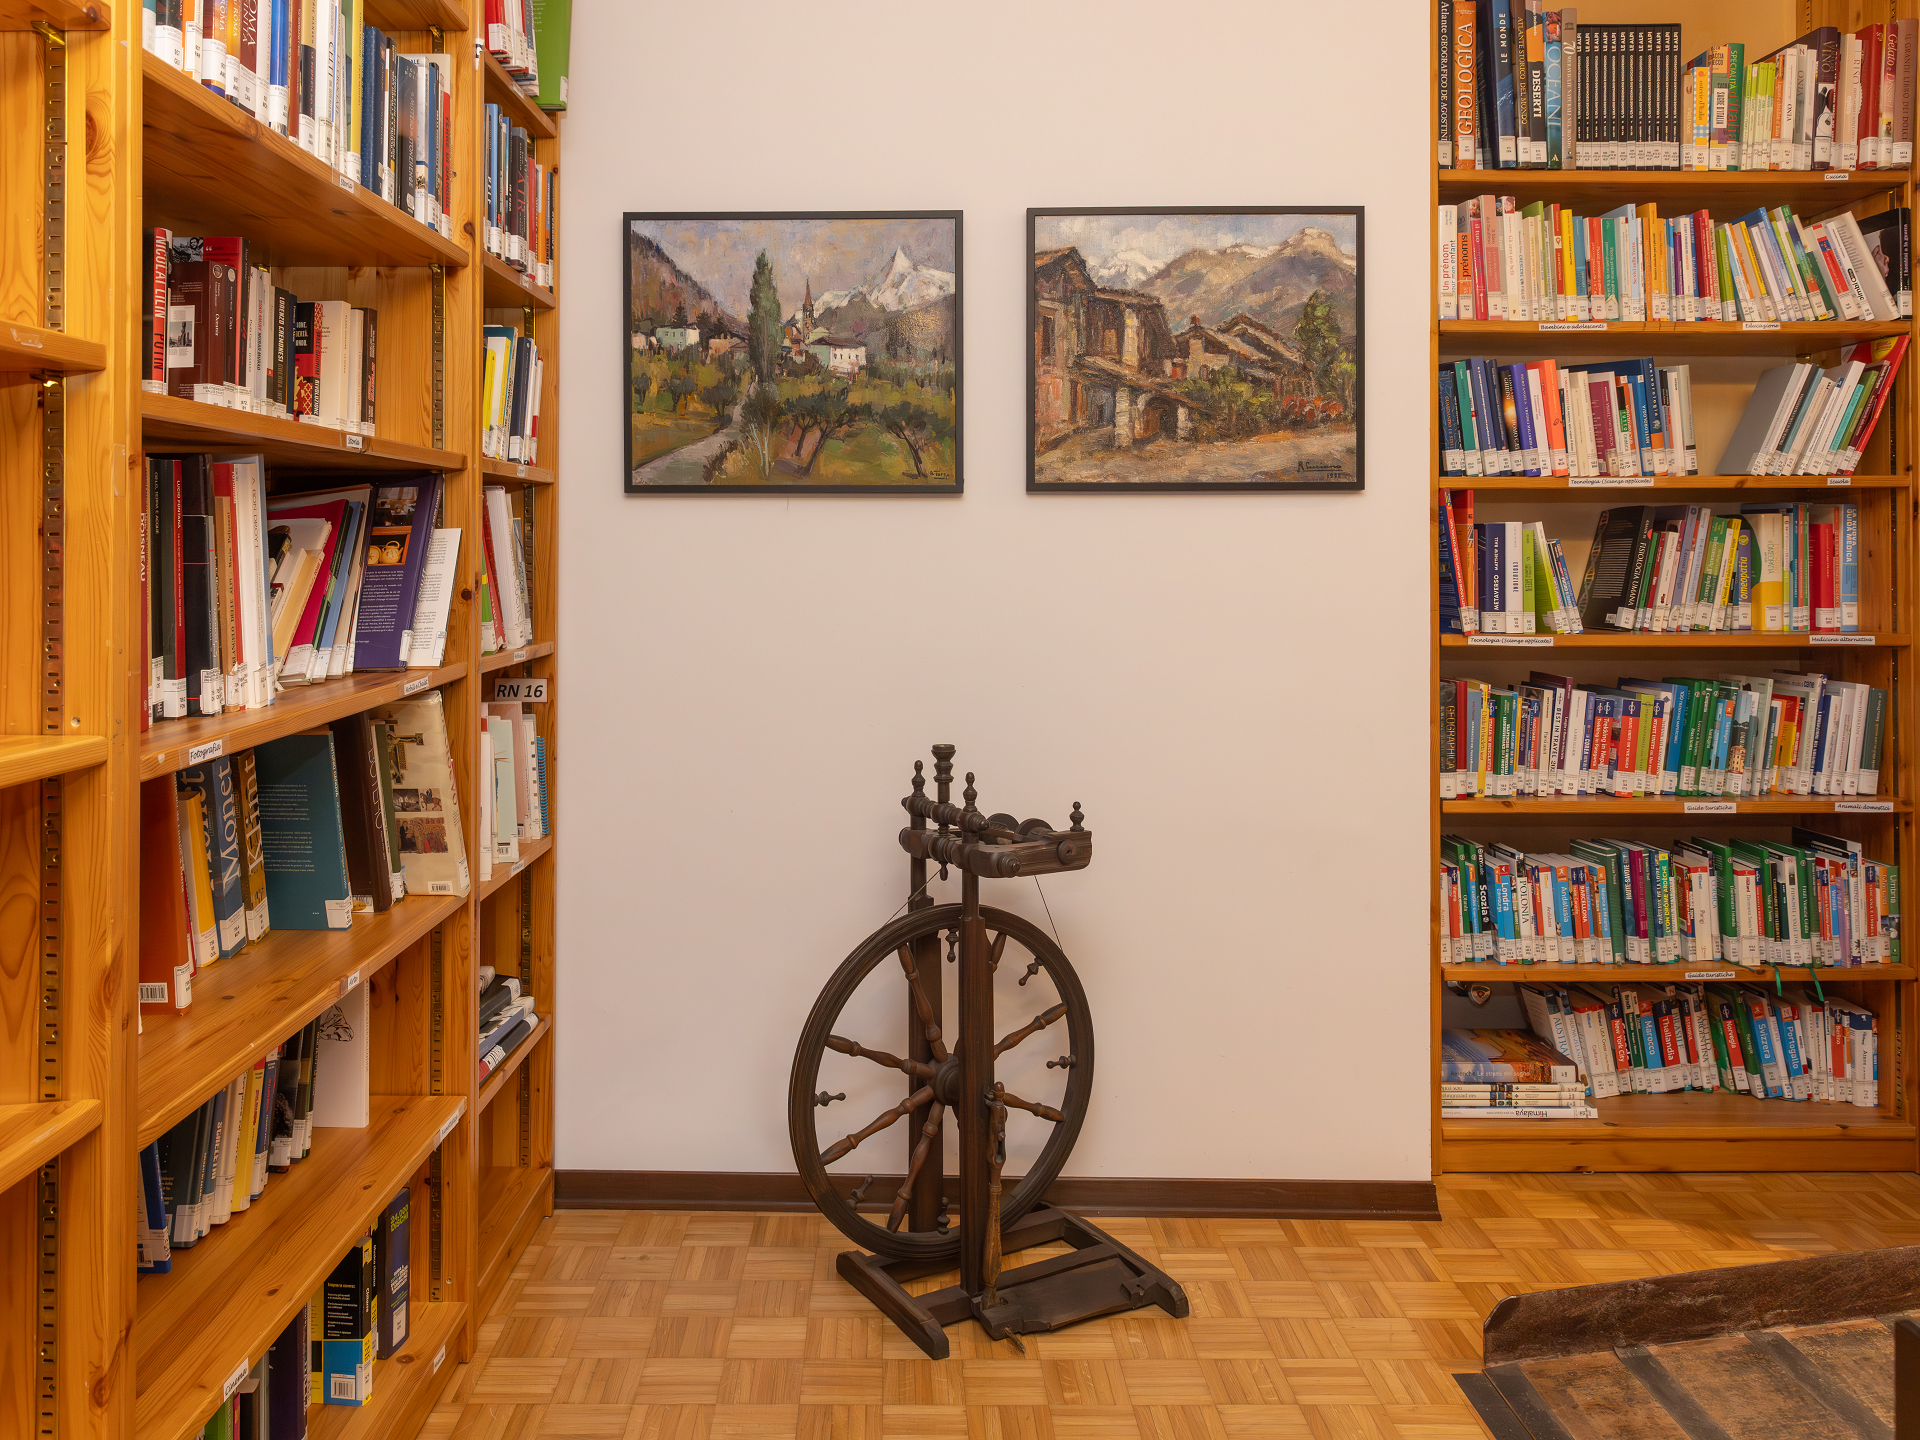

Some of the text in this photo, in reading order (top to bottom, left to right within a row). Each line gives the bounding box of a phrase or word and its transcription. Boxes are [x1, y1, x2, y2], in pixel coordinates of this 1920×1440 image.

[1441, 1, 1449, 33] Atlante
[1501, 53, 1507, 63] LE
[1563, 41, 1576, 55] 70
[1821, 41, 1832, 73] VINO
[1458, 22, 1473, 135] GEOLOGICA
[1547, 46, 1561, 126] OCEANI
[1797, 70, 1805, 97] VINO
[1852, 59, 1860, 84] RISO
[1886, 34, 1897, 108] Gelato Dessert
[1441, 90, 1448, 101] DE
[1532, 70, 1541, 118] DESERTI
[1716, 92, 1726, 106] SAGRE
[1727, 50, 1741, 141] SPECIALITÀ d'Italia
[407, 137, 415, 188] STONEHENGE
[517, 171, 525, 212] AIR
[1441, 244, 1449, 290] Un prénom
[1459, 234, 1471, 277] prénoms
[154, 235, 166, 370] NICOLAI LILIN PUTIN
[277, 326, 285, 362] CREMONESI
[1852, 509, 1856, 518] LA
[1628, 542, 1646, 606] FISIOLOGIA UMANA
[497, 685, 543, 698] RN 16
[1803, 680, 1815, 688] cane
[190, 743, 221, 761] Fotografia
[1446, 705, 1456, 770] GEOGRAPHICA
[219, 760, 241, 890] Monet
[244, 755, 263, 872] Klimt
[1480, 885, 1488, 915] Scozia
[1501, 882, 1510, 911] Londra
[1520, 880, 1529, 923] POLONIA
[1561, 887, 1569, 923] Andalusia
[1889, 875, 1897, 903] Umbria
[1644, 1020, 1655, 1055] Marocco
[1661, 1017, 1675, 1061] Thailandia
[1672, 1012, 1684, 1049] BRASILE
[1697, 1015, 1708, 1063] ARGENTINA
[1726, 1021, 1736, 1049] Norvegia
[1758, 1024, 1771, 1059] Svizzera
[1787, 1026, 1799, 1069] Portogallo
[390, 1204, 409, 1223] 24.000
[391, 1213, 409, 1232] DISCHI
[225, 1368, 247, 1396] Cinema
